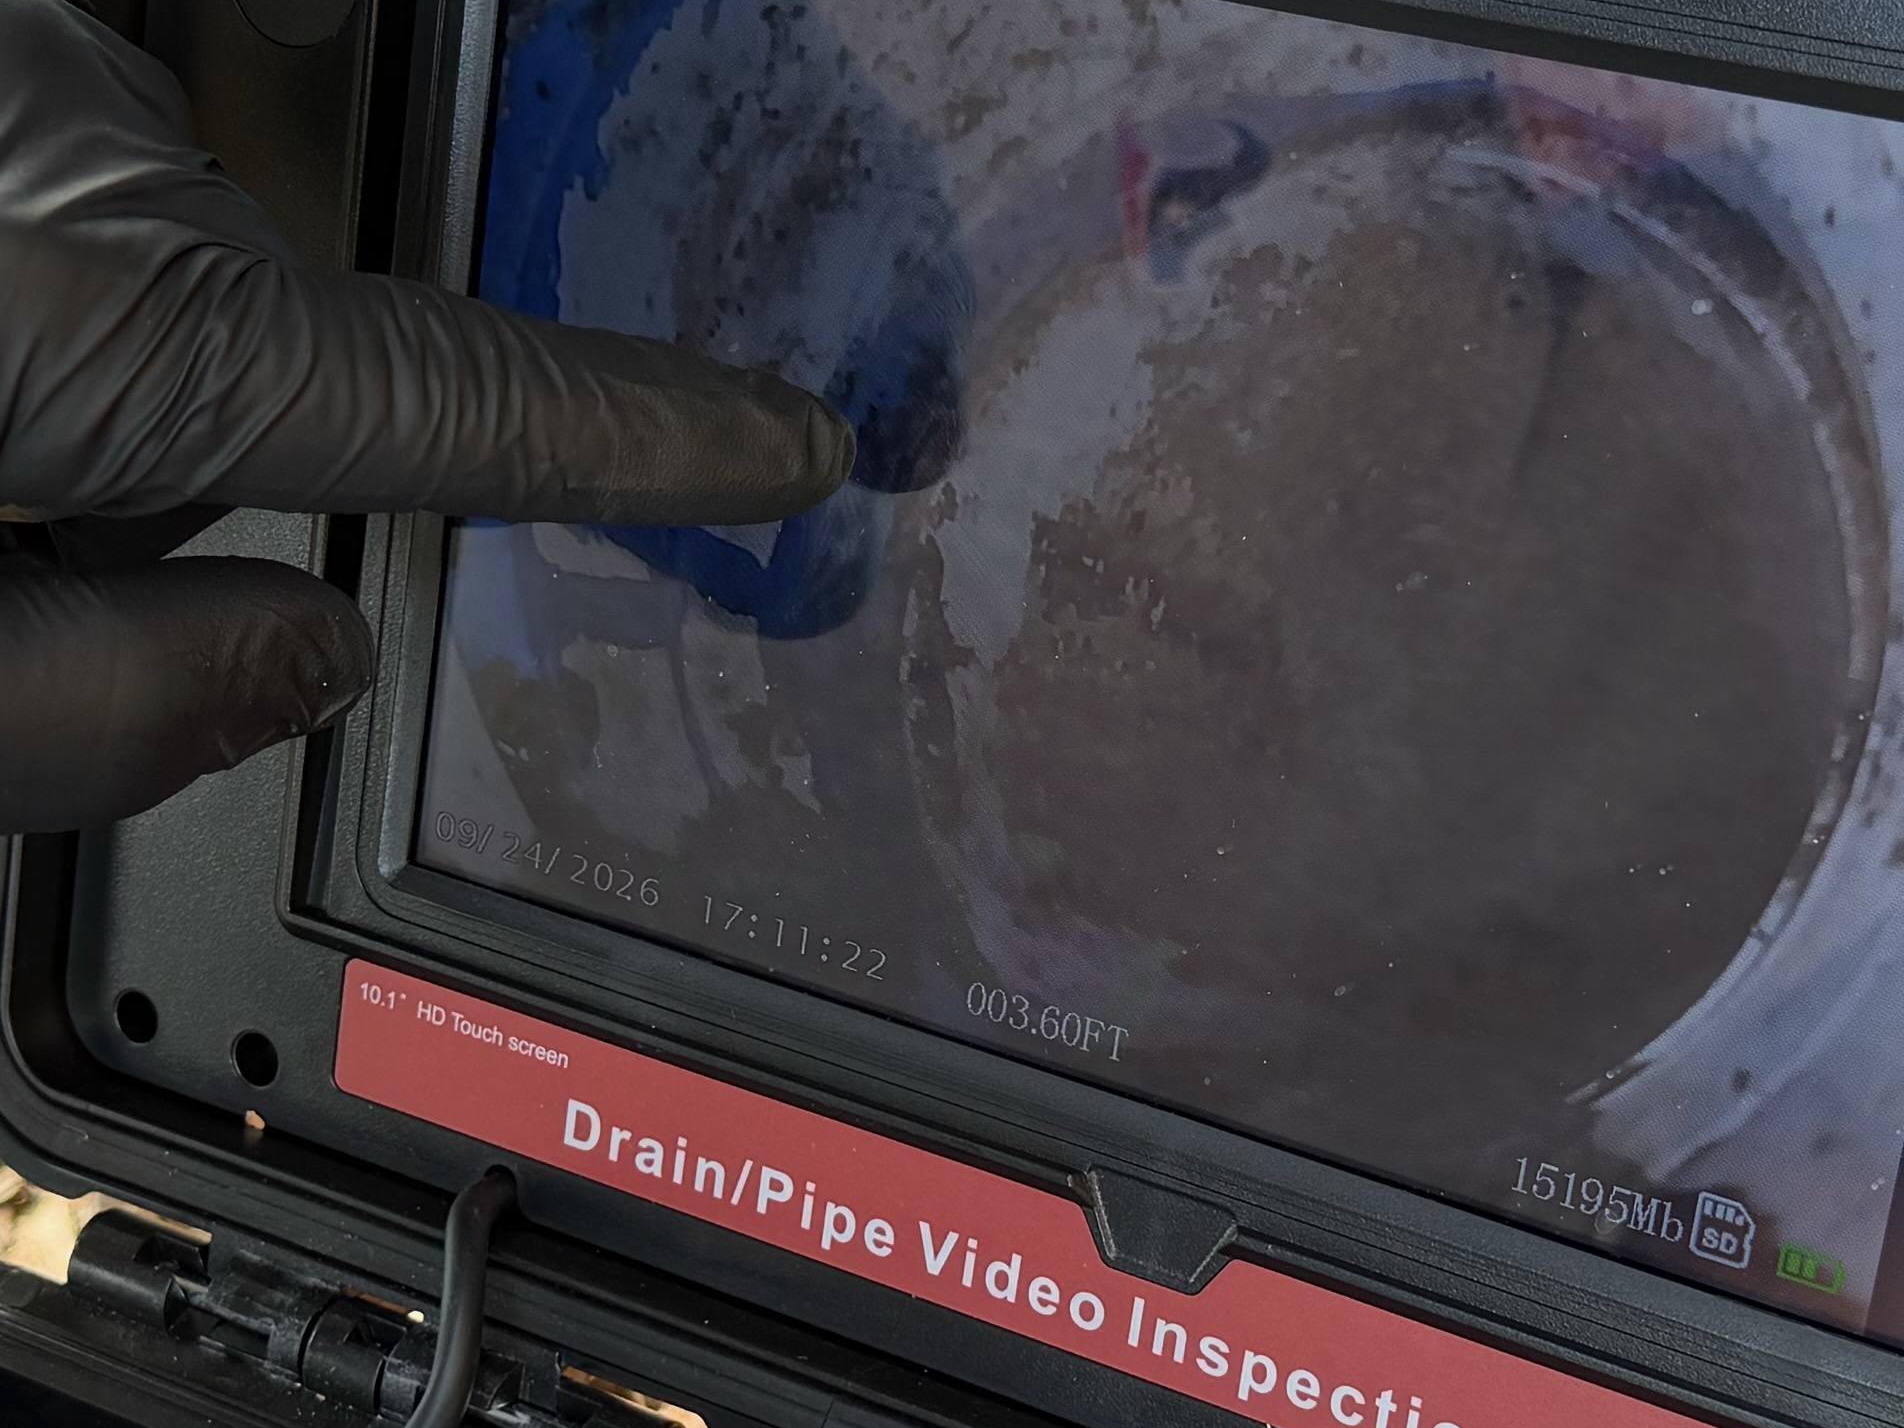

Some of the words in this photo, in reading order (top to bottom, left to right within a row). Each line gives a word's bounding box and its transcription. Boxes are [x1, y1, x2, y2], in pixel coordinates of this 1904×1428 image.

[701, 894, 888, 981] 17:11:22
[416, 1000, 446, 1026] HD
[451, 1011, 503, 1046] Touch
[508, 1035, 569, 1069] screen
[966, 981, 1129, 1063] 003.60FT
[562, 1098, 895, 1258] Drain/Pipe
[918, 1221, 1106, 1332] Video
[1510, 1156, 1685, 1243] 15195Mb
[1701, 1227, 1740, 1256] SD
